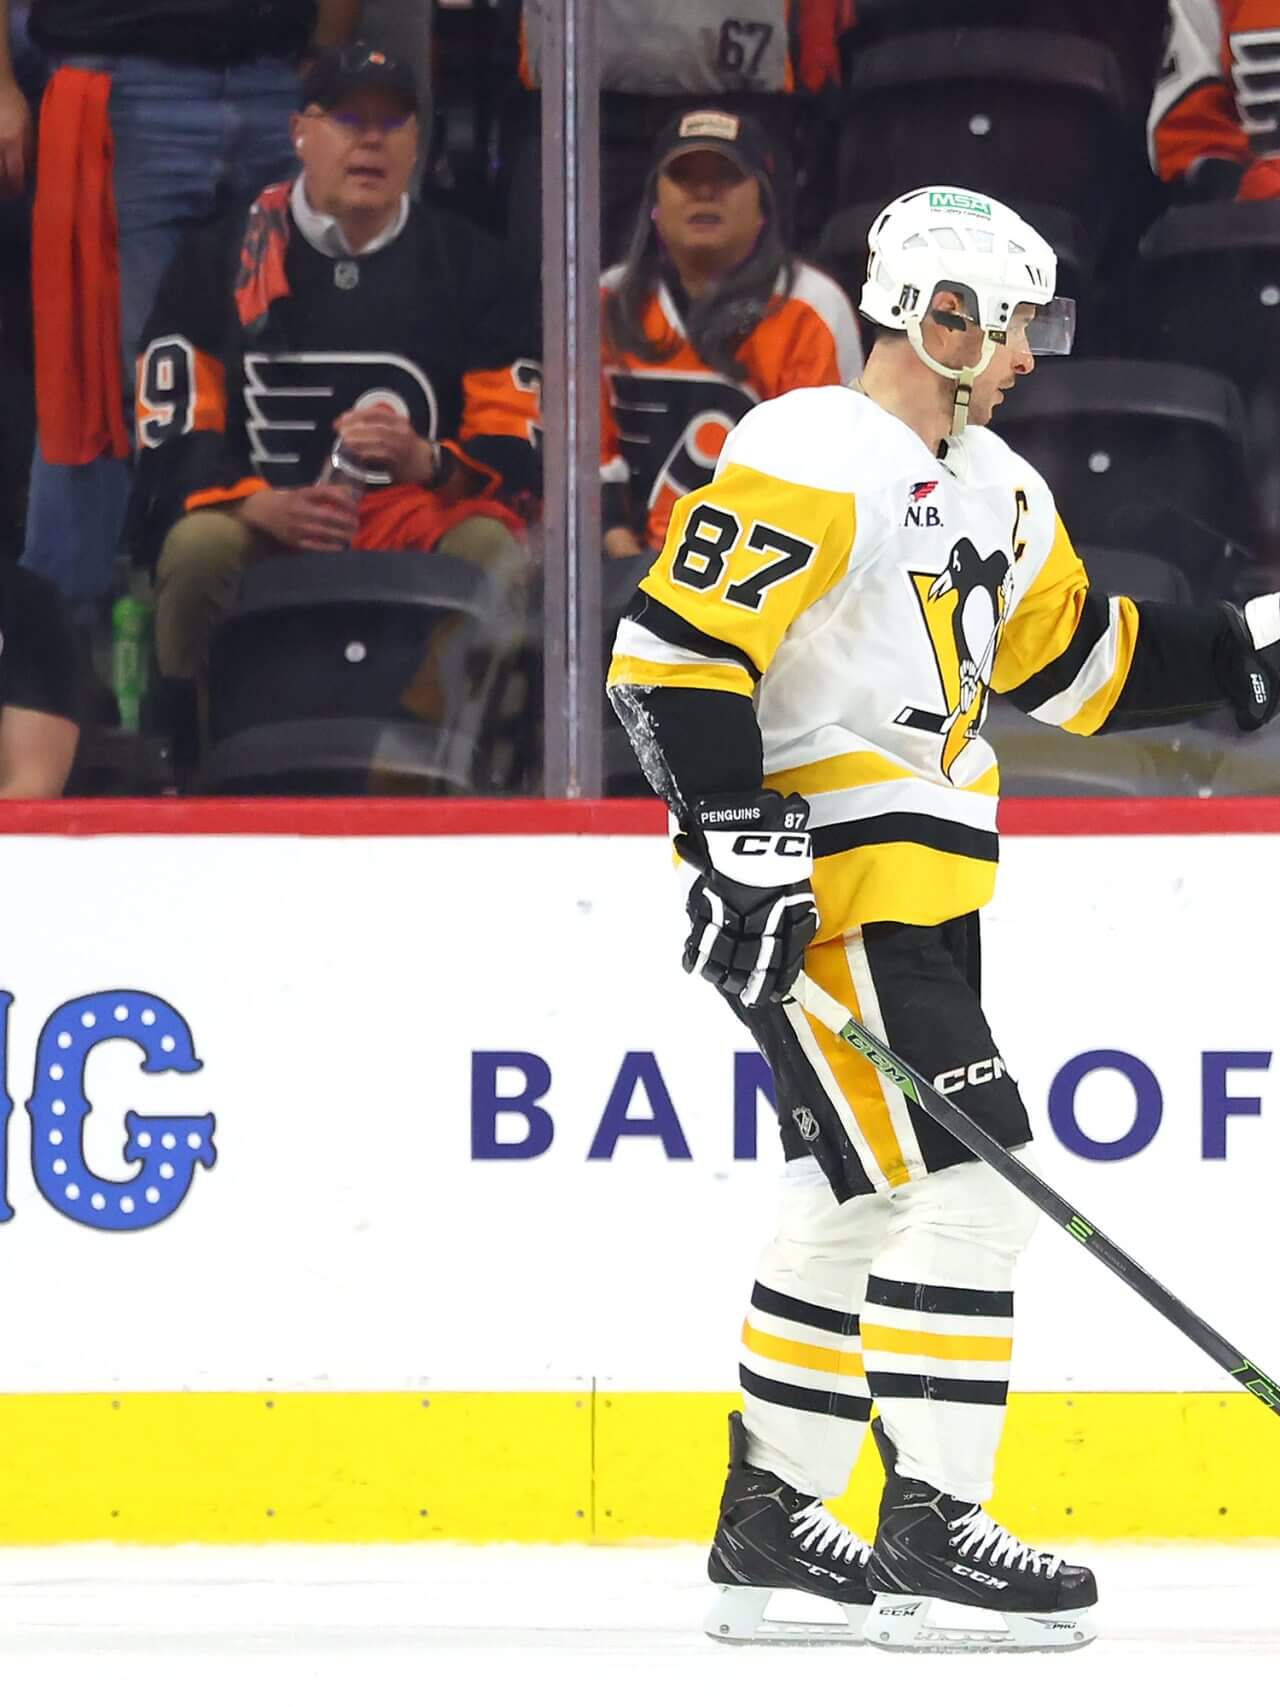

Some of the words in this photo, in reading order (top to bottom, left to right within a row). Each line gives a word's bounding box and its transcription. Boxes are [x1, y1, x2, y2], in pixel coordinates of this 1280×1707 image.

[718, 17, 774, 75] 67
[930, 192, 992, 215] MSA
[1012, 489, 1029, 563] C
[670, 500, 818, 614] 87
[700, 807, 761, 824] PENGUINS
[783, 813, 805, 829] 87
[846, 1031, 907, 1084] CCM
[0, 989, 217, 1231] G
[472, 1051, 779, 1160] BAN
[1048, 1050, 1272, 1161] OF
[951, 1564, 1010, 1590] CCM
[879, 1608, 917, 1617] CCM
